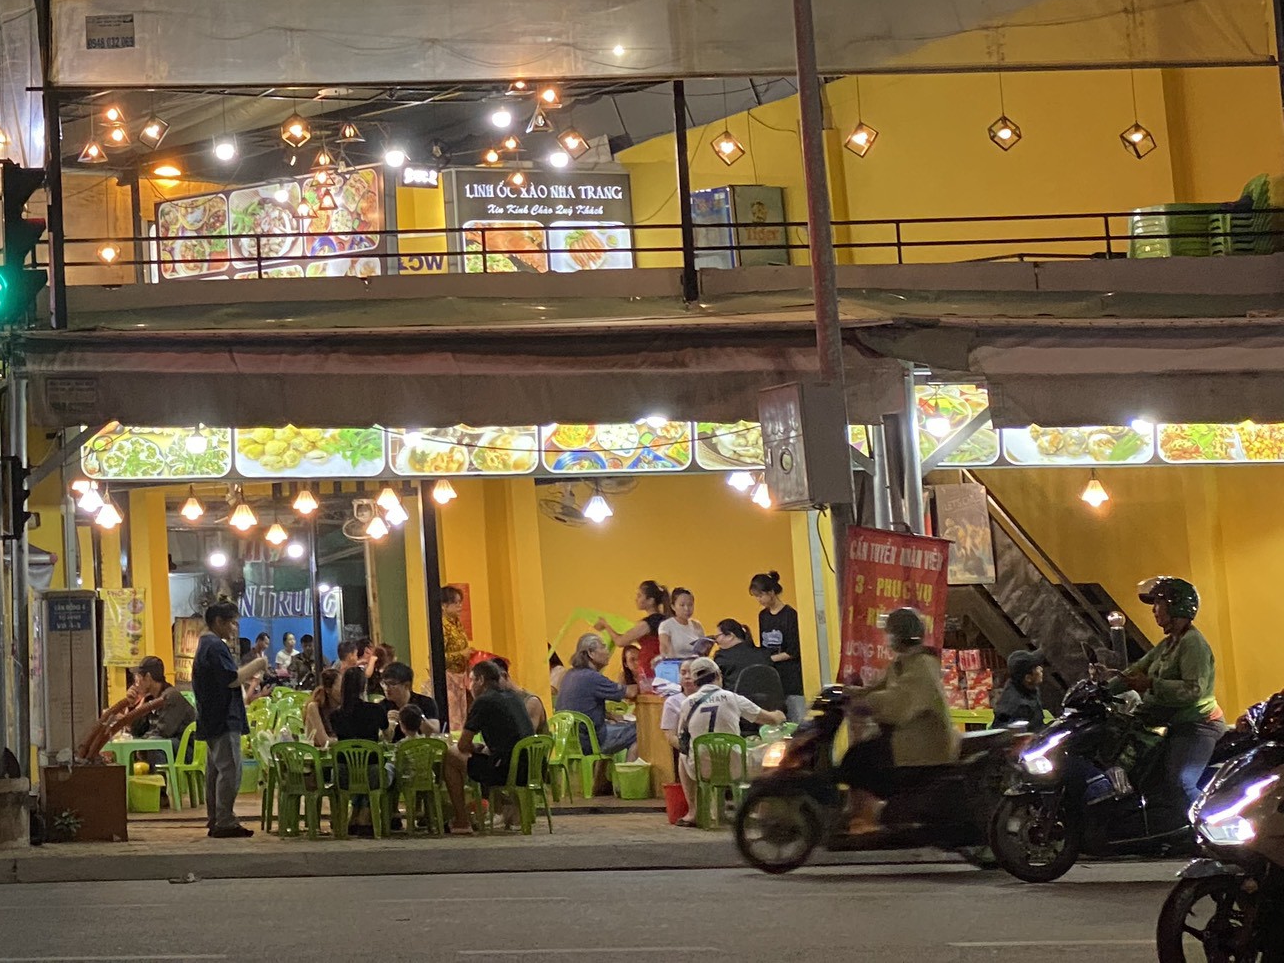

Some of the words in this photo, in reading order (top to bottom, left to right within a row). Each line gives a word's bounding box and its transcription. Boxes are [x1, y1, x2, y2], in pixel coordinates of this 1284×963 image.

[465, 183, 494, 198] LINH
[520, 182, 548, 199] XÀO
[550, 184, 576, 199] NHA
[578, 185, 623, 200] TRANG
[855, 574, 865, 594] 3
[700, 706, 719, 733] 7
